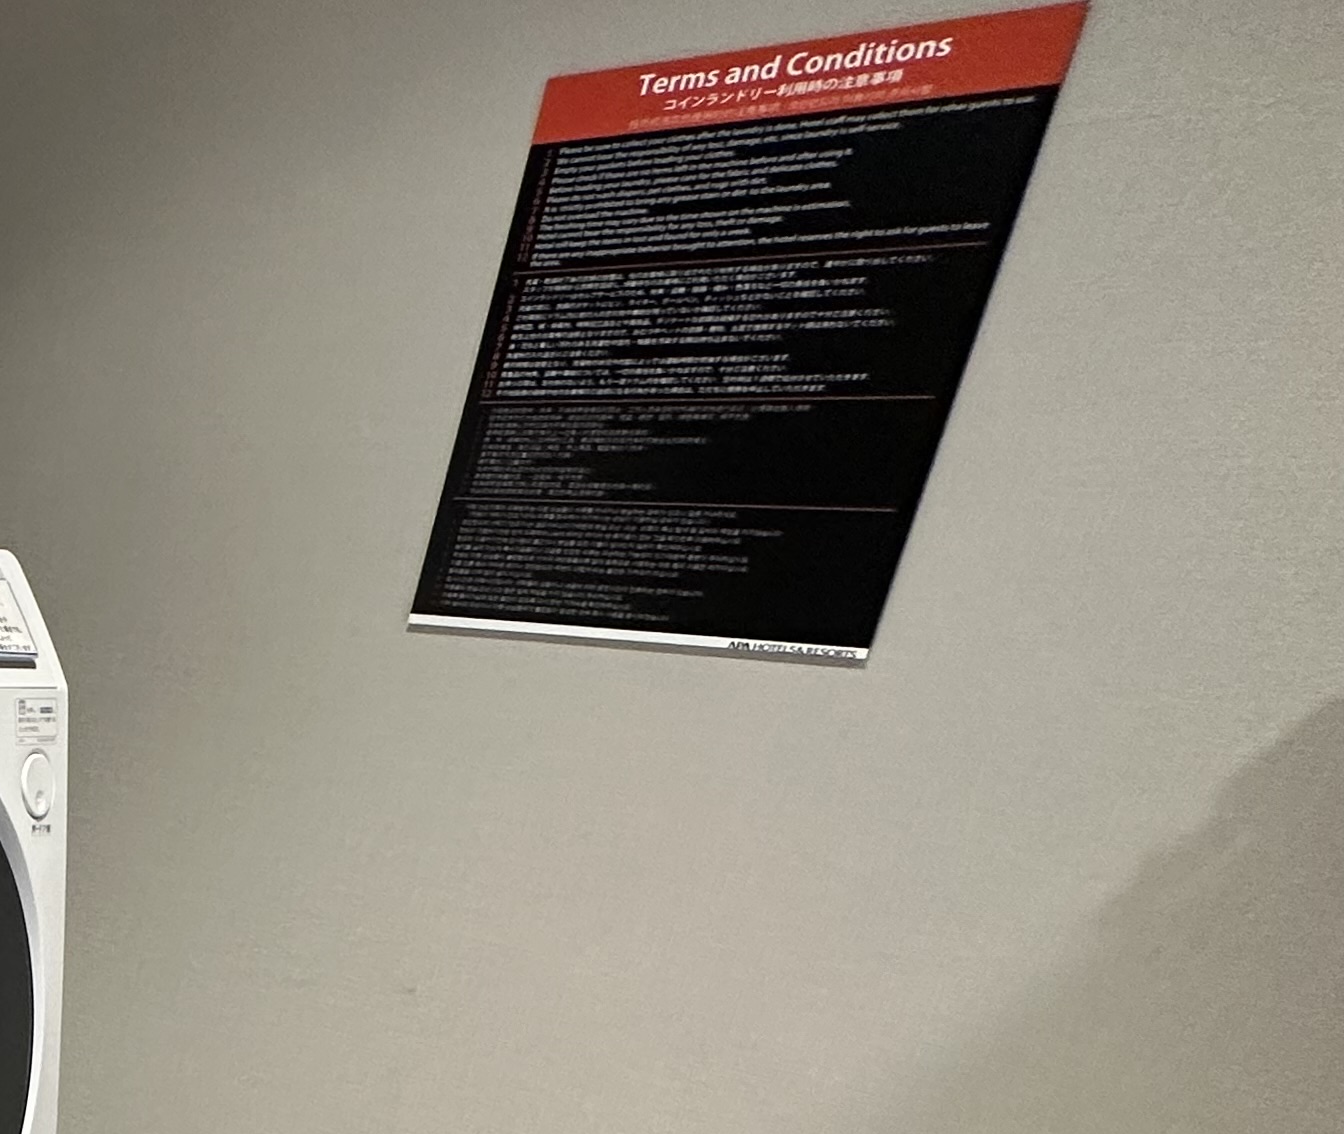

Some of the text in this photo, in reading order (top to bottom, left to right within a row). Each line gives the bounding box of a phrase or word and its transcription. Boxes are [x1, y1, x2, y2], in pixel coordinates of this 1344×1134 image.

[639, 36, 954, 97] Terms and Conditions
[663, 68, 905, 112] コインランドリー利用時の注意事項
